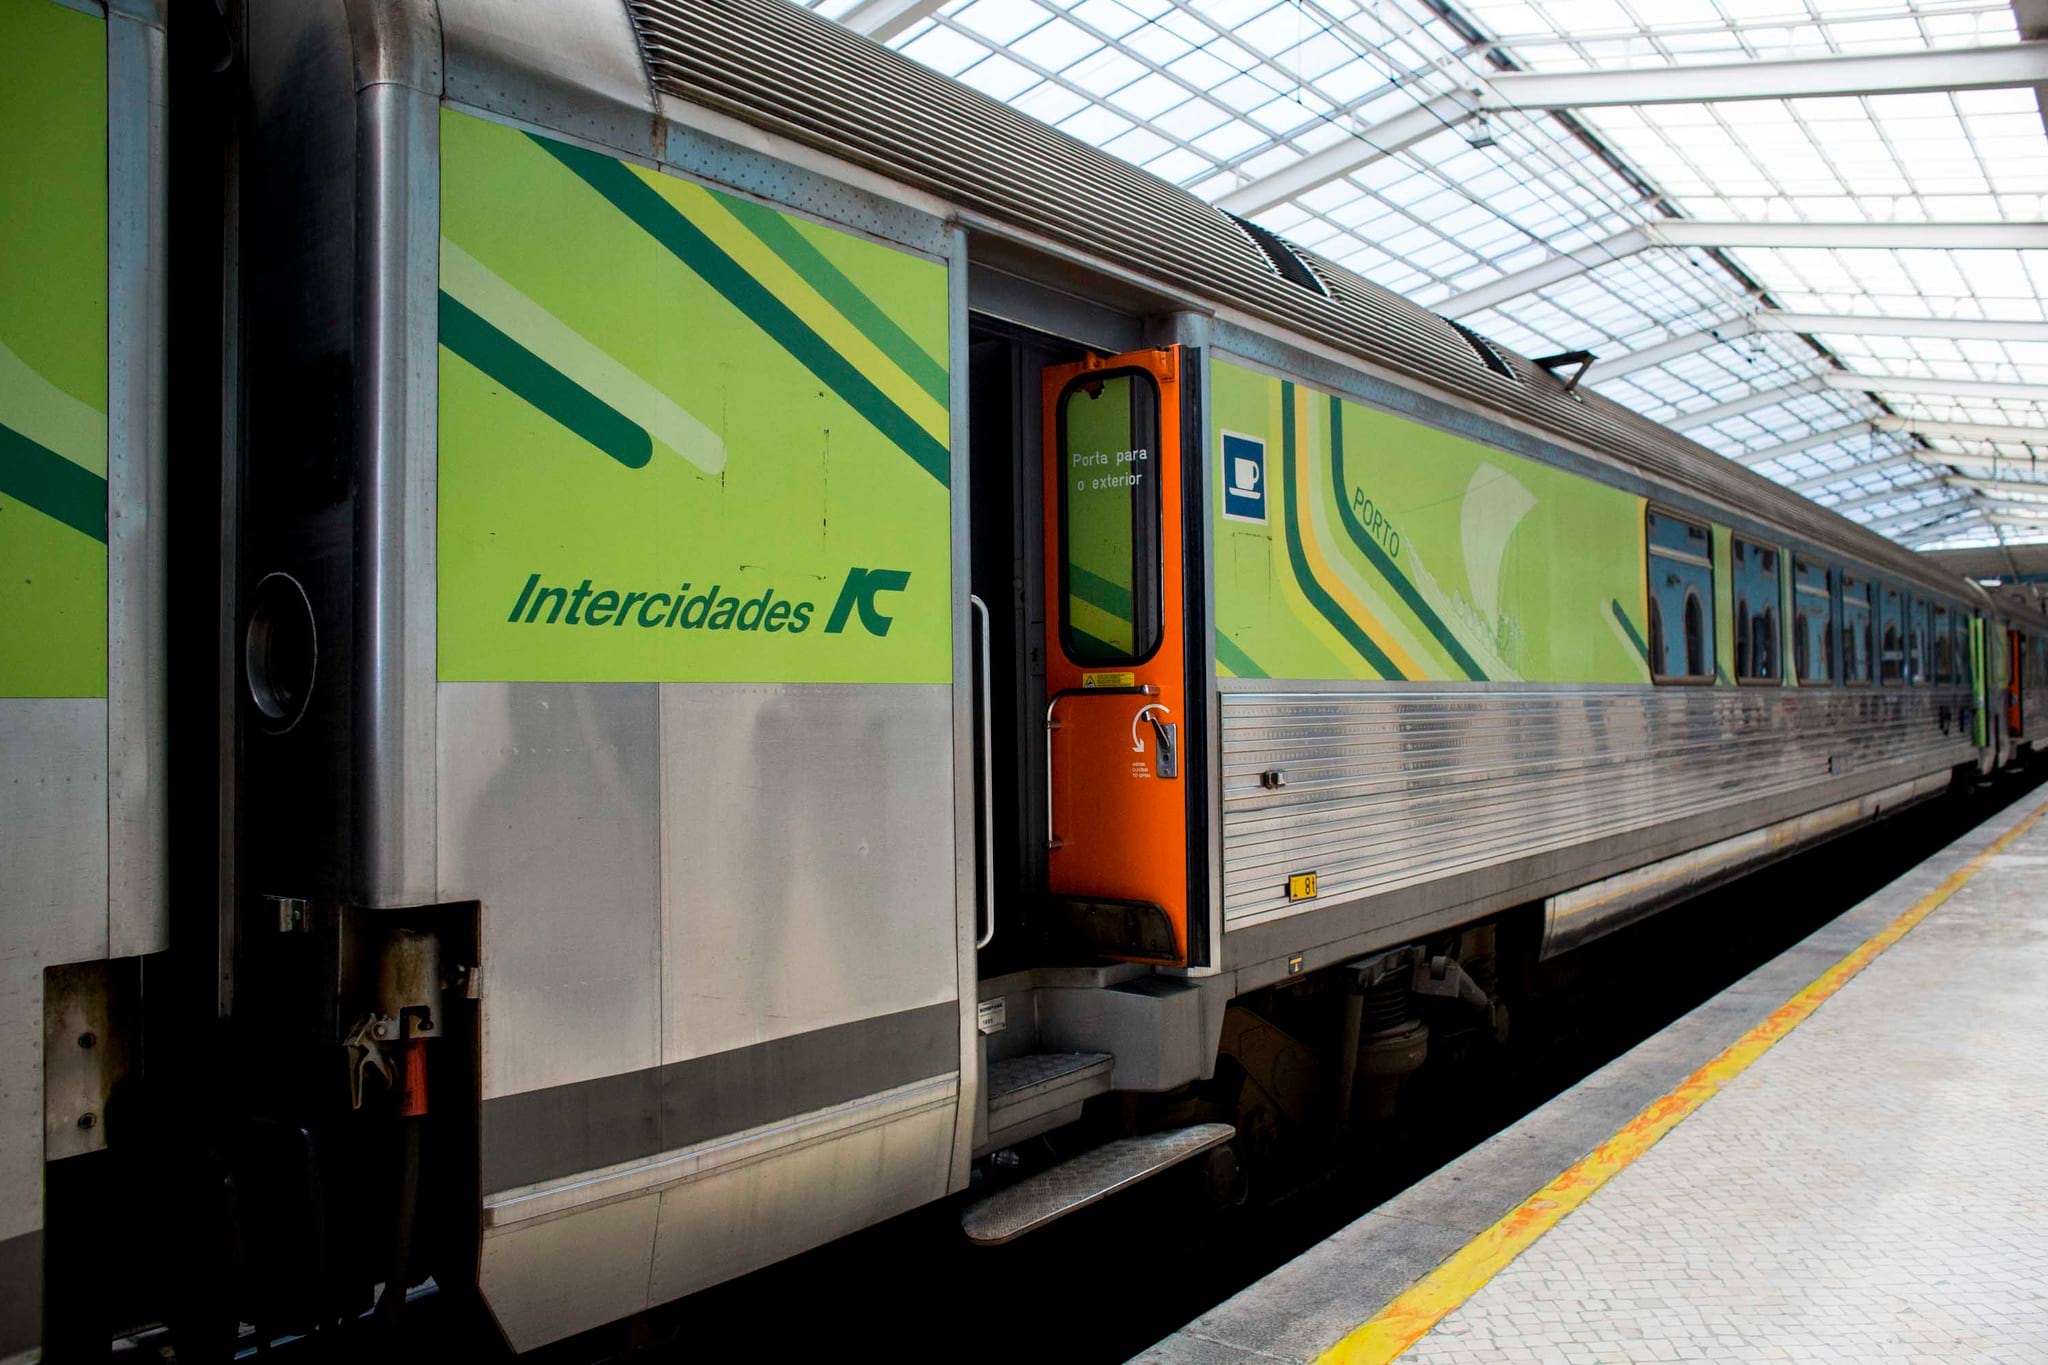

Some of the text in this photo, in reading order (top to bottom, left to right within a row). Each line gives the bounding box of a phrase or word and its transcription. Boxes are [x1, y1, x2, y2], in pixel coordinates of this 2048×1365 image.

[1073, 449, 1148, 467] Porta para
[1077, 472, 1142, 491] o exterior
[1353, 486, 1400, 558] PORTO
[507, 573, 814, 634] Intercidades
